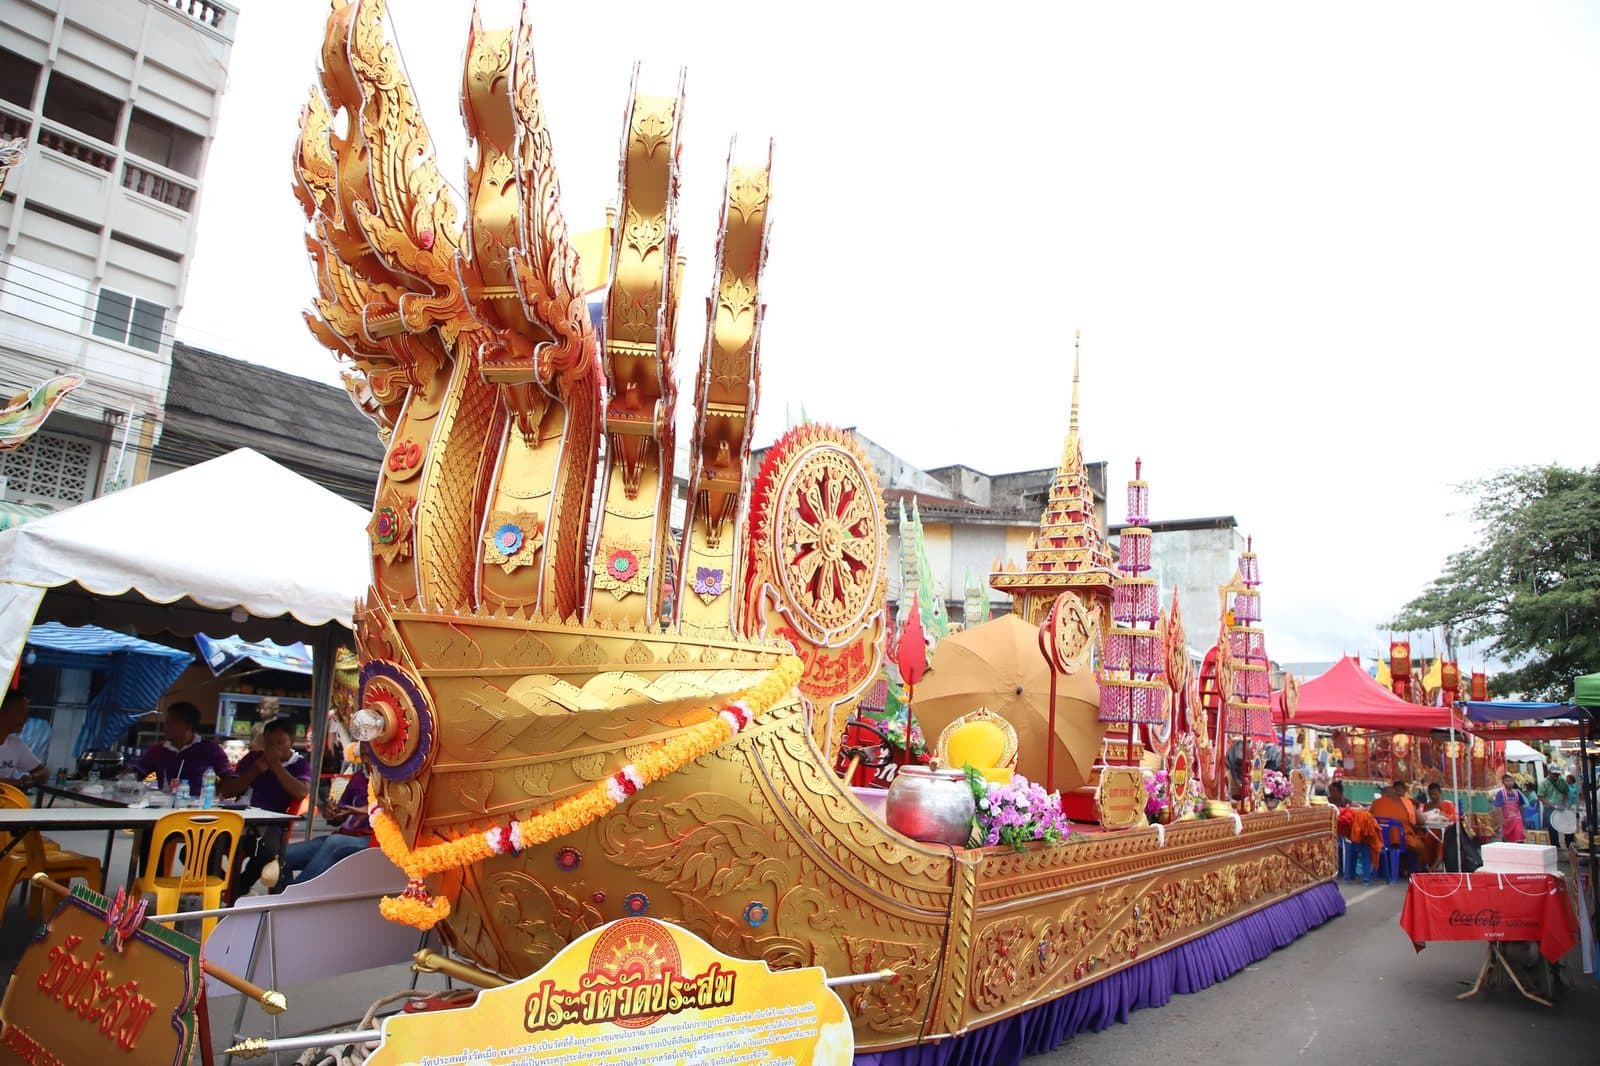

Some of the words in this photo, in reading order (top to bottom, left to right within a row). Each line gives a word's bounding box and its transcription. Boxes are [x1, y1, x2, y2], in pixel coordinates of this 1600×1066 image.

[1449, 909, 1503, 927] Coca-Cola
[526, 964, 736, 1031] ประวัติวัดประสพ
